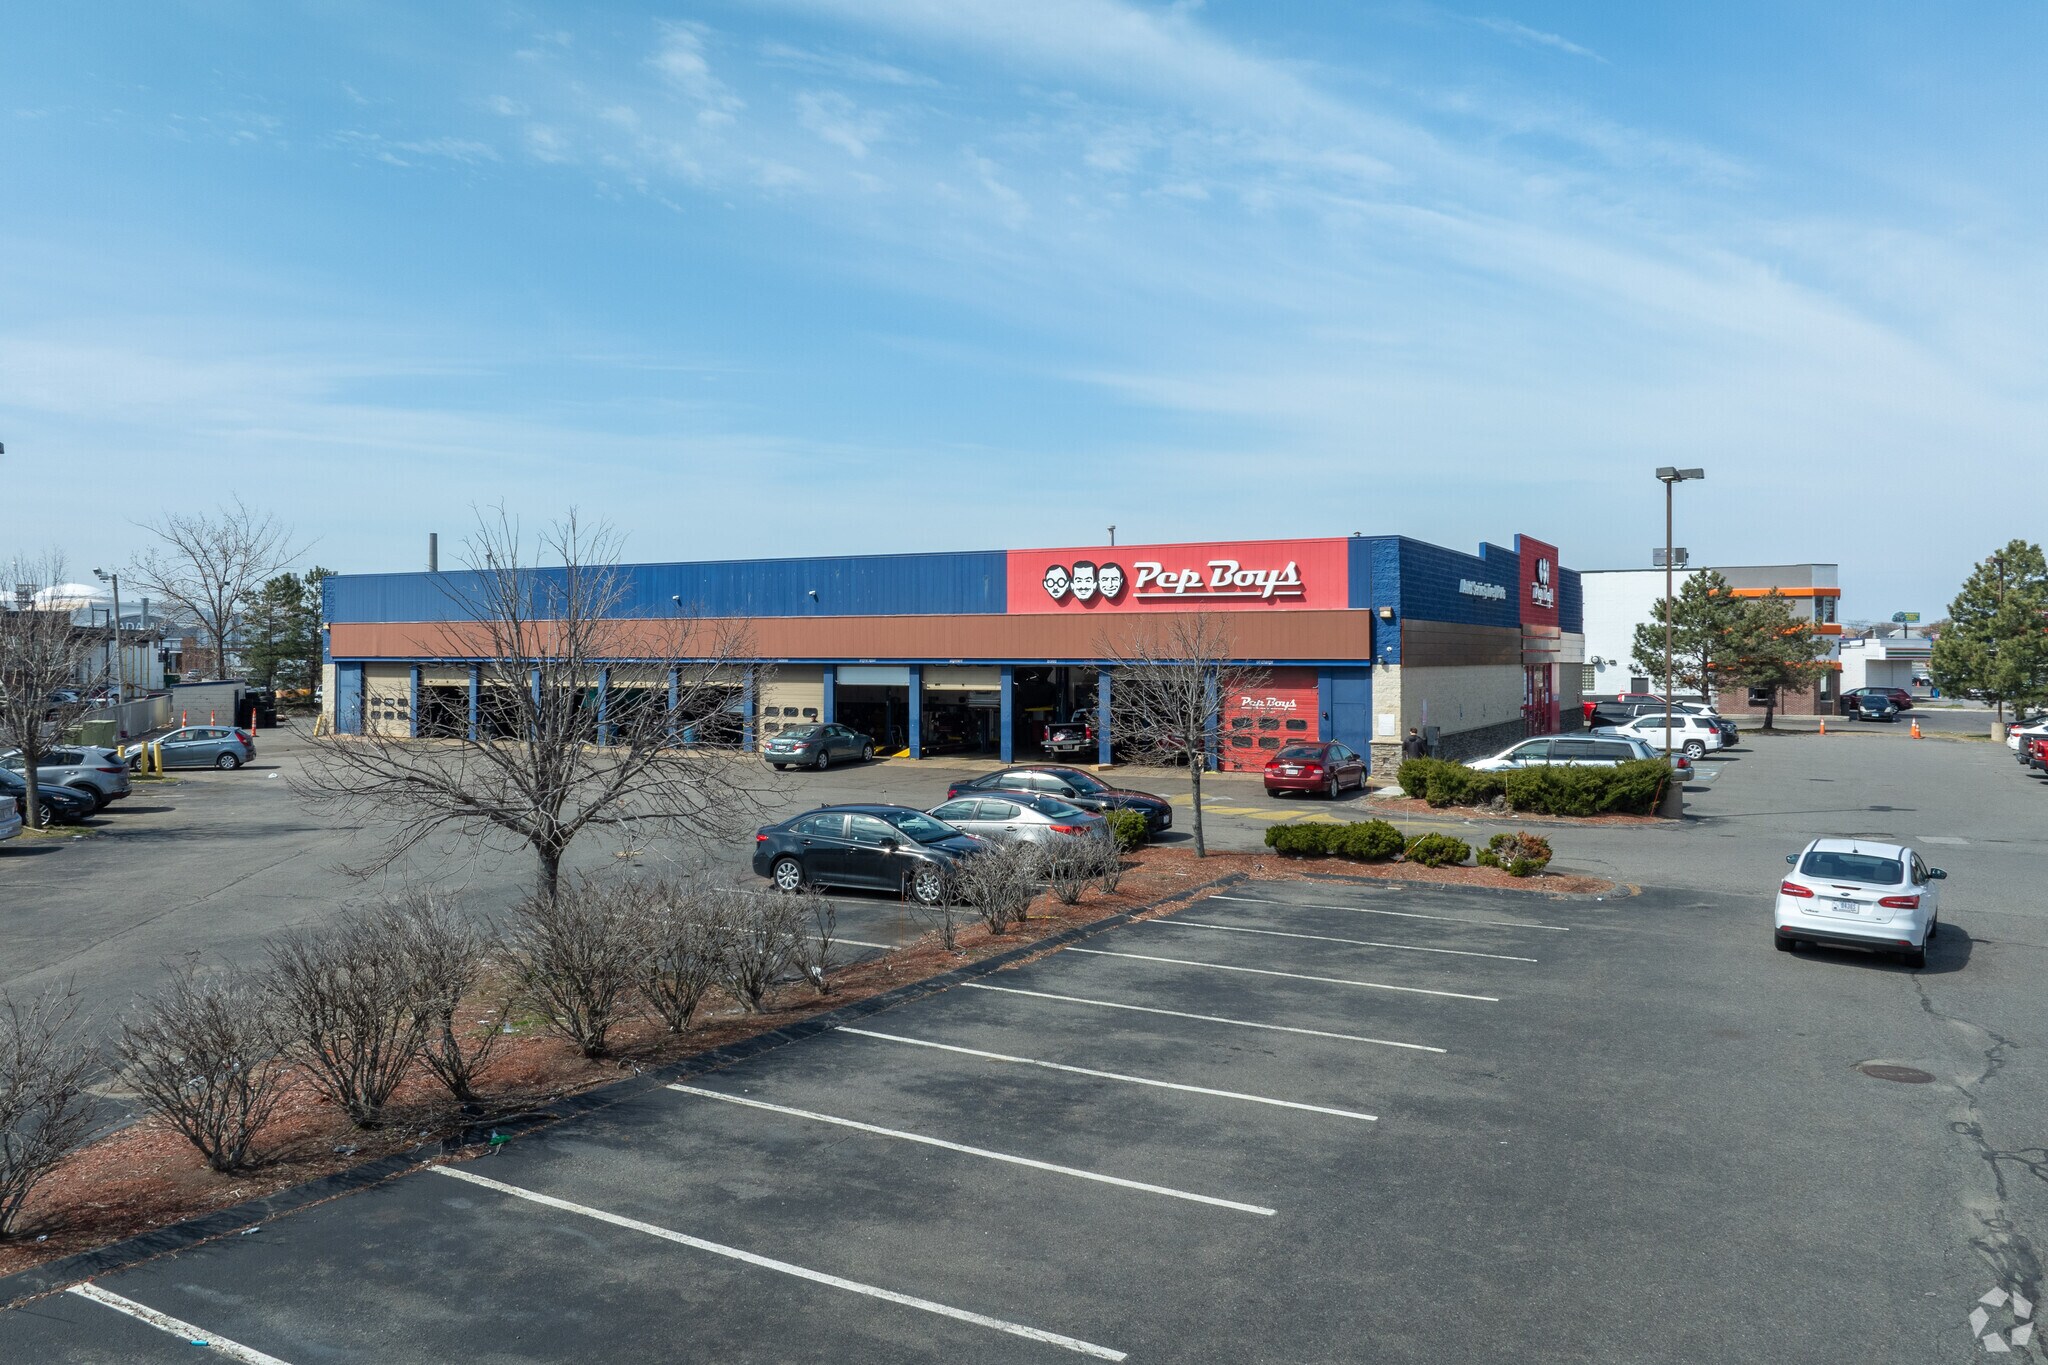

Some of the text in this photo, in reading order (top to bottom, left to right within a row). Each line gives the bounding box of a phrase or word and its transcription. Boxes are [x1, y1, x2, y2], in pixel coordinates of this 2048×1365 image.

[1133, 560, 1302, 598] Pep Boys
[1241, 697, 1297, 711] Pep Boys
